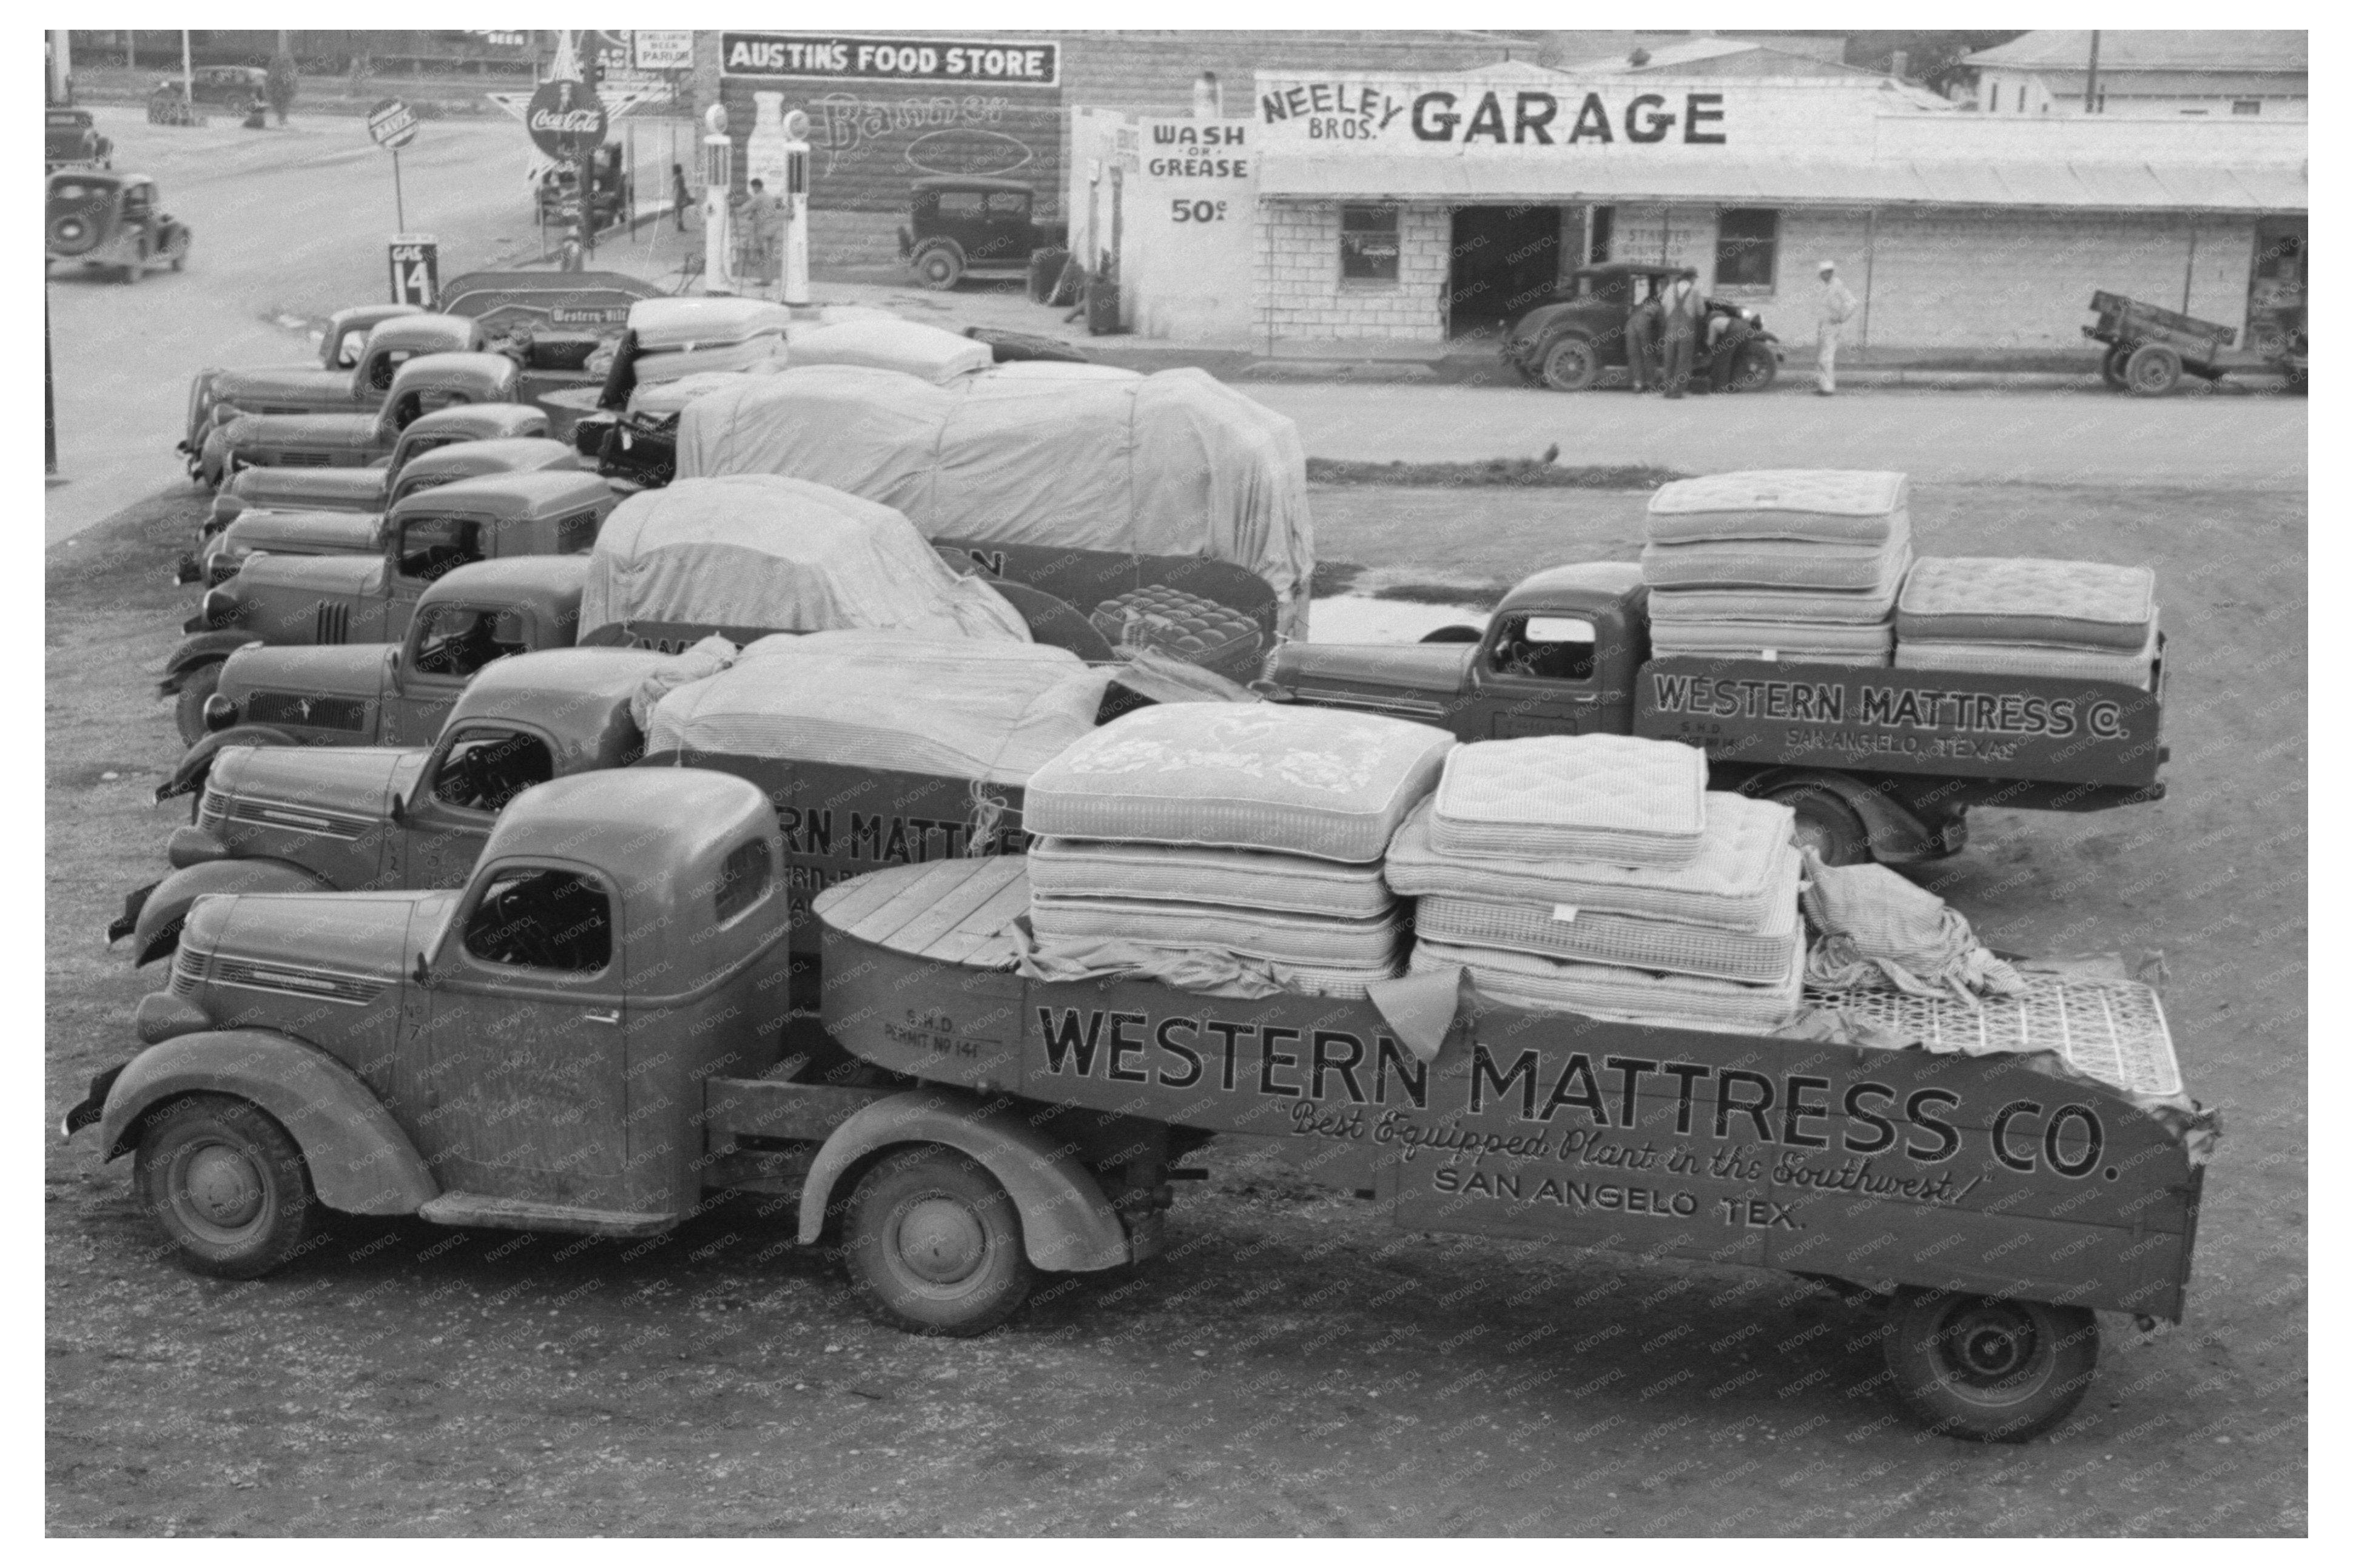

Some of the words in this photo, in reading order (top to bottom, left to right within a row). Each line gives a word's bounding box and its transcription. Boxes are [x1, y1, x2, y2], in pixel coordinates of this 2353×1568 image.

[487, 33, 524, 45] BEER
[729, 39, 848, 69] AUSTIN'S
[858, 45, 938, 73] FOOD
[946, 48, 1045, 77] STORE
[1262, 84, 1404, 130] NEELEY
[1412, 91, 1728, 144] GARAGE
[1310, 118, 1377, 140] BROS.
[1153, 125, 1245, 146] WASH
[1188, 146, 1211, 156] OR
[1149, 158, 1248, 178] GREASE
[392, 245, 423, 262] GAS
[394, 261, 432, 306] 14
[1653, 673, 1845, 724] WESTERN
[1860, 685, 2077, 737] MATTRESS
[1786, 727, 1823, 749] SAN
[1939, 736, 2018, 761] TEXAS
[1037, 1006, 1430, 1110] WESTERN
[1467, 1043, 1962, 1163] MATTRESS
[1990, 1099, 2120, 1181] CO.
[1372, 1111, 1549, 1166] Equipped
[1557, 1129, 1656, 1173] Plant
[1666, 1144, 1700, 1176] in
[1708, 1145, 1763, 1183] the
[1432, 1168, 1520, 1200] SAN
[1529, 1178, 1700, 1219] ANGELO
[1718, 1195, 1808, 1231] TEX.
